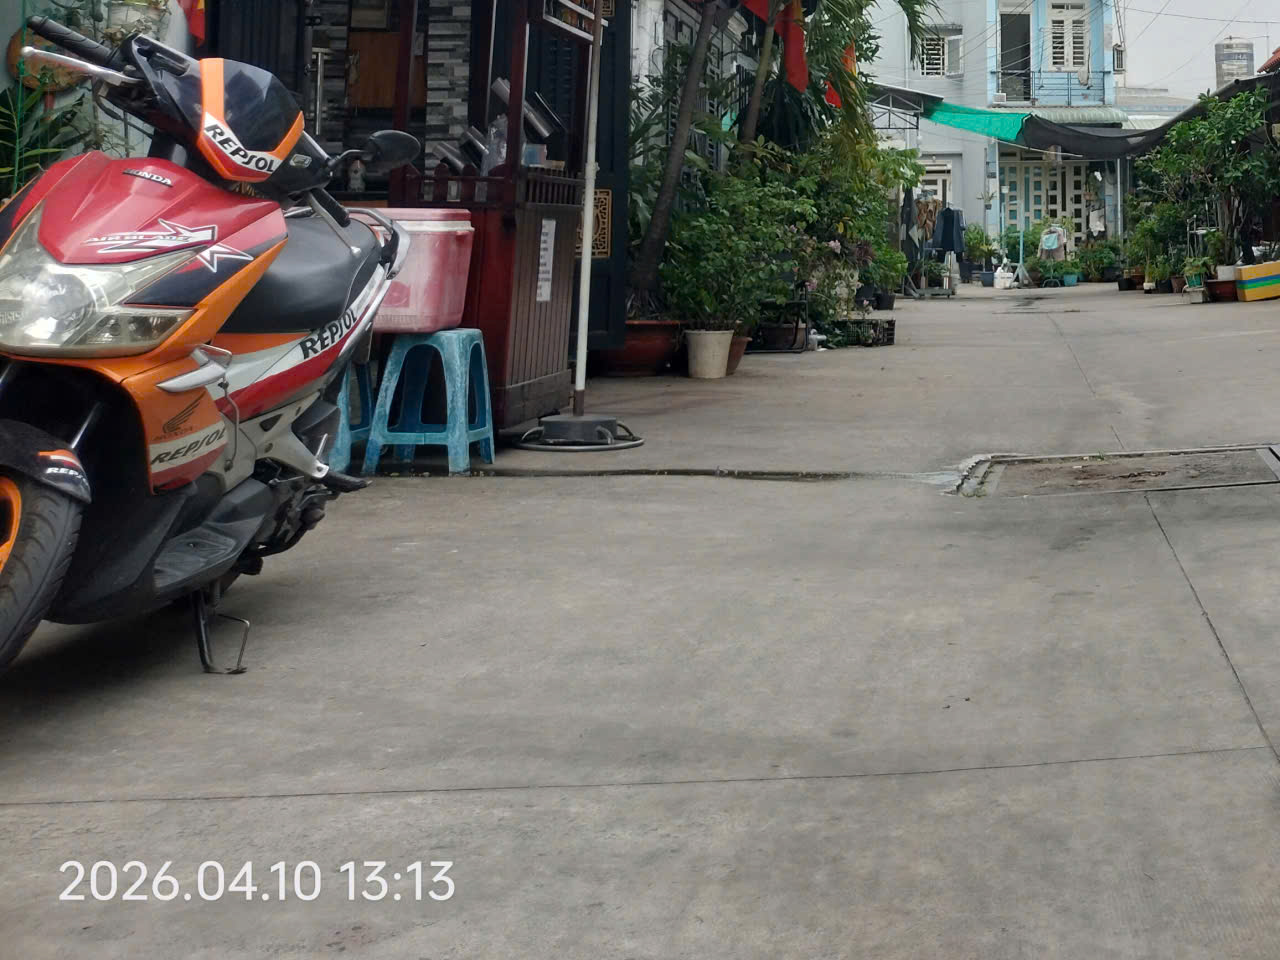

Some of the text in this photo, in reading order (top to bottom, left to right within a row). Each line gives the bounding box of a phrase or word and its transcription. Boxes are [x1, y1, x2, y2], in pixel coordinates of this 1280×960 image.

[204, 124, 274, 172] REPSOL
[123, 169, 173, 187] HONDA
[299, 308, 357, 359] REPSOL
[151, 427, 226, 465] REPSOL
